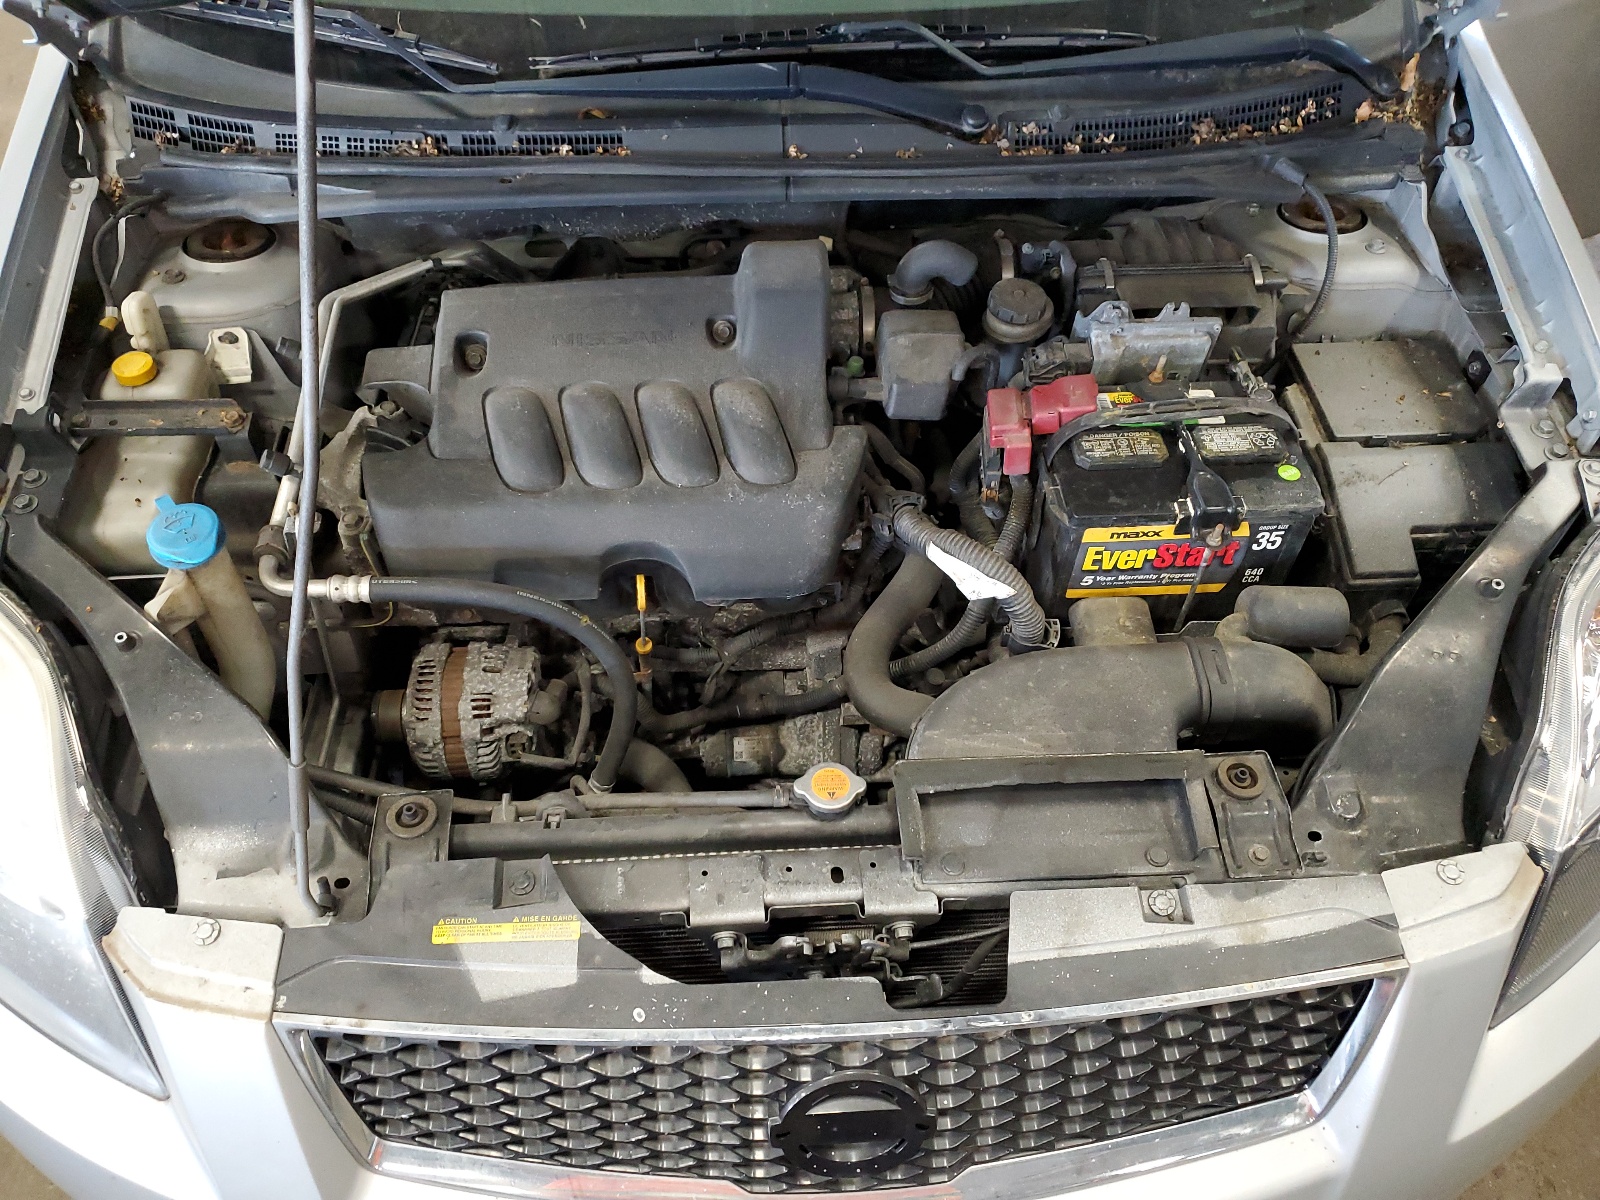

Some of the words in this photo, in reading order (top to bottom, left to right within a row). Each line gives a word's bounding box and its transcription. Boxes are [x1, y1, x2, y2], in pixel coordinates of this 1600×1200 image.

[1110, 530, 1164, 540] maxx
[1251, 531, 1286, 551] 35
[1244, 567, 1265, 576] 640
[1079, 575, 1095, 586] 5
[445, 917, 478, 925] CAUTION
[521, 915, 539, 923] MISE
[552, 914, 578, 922] GARDE
